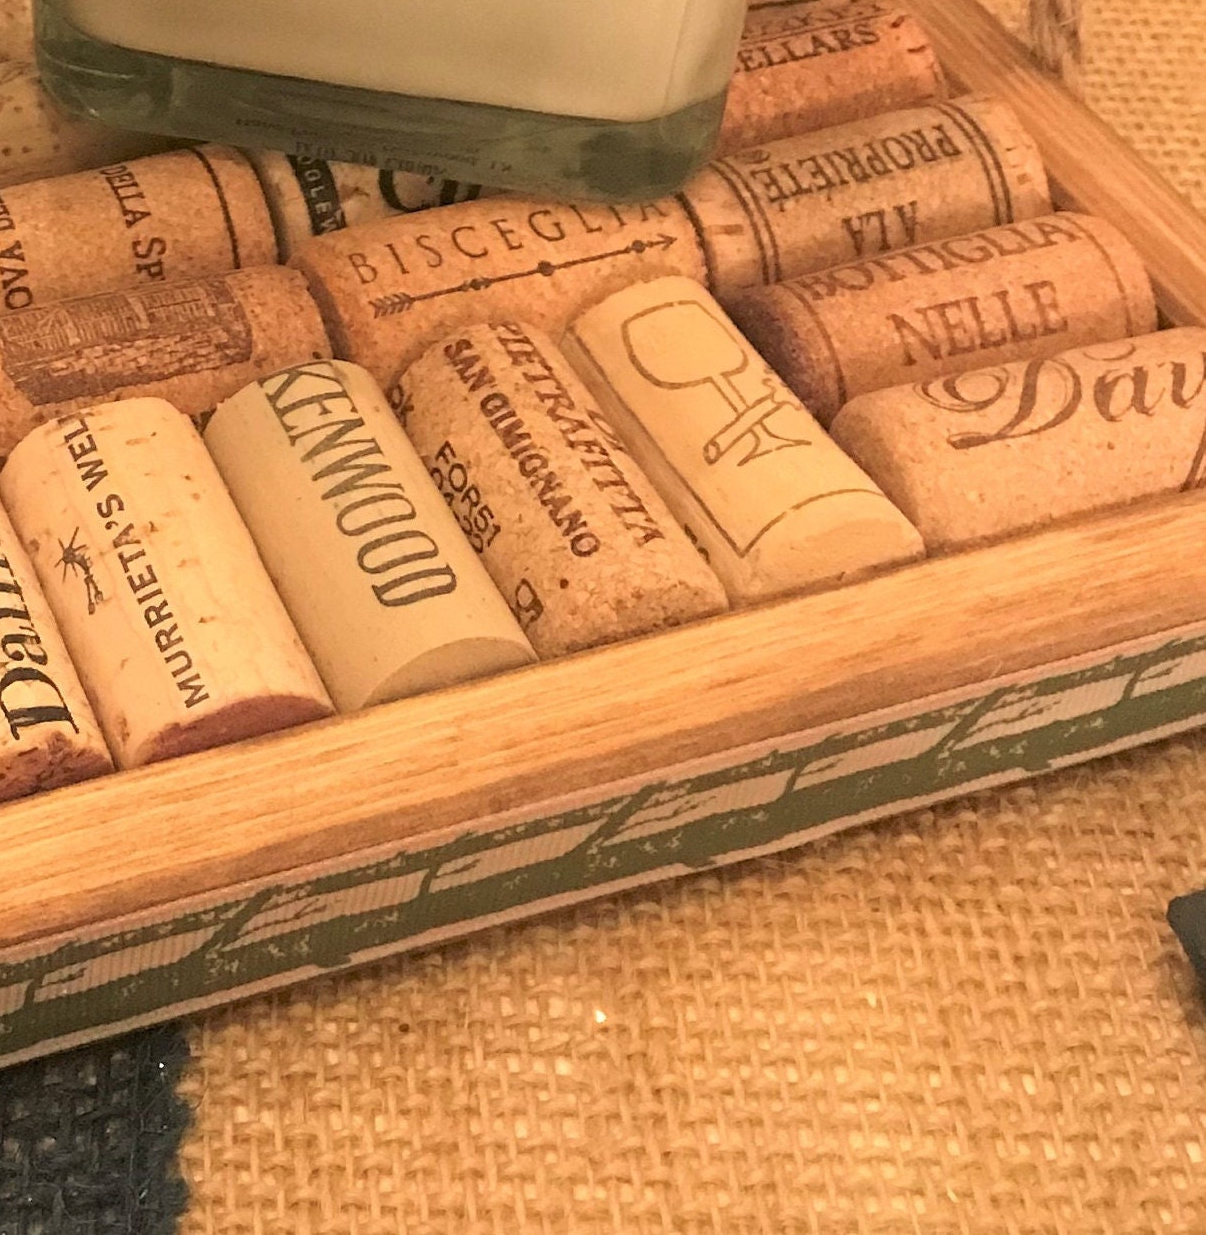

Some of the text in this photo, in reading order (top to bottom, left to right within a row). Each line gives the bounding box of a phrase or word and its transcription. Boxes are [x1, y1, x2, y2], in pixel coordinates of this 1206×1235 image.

[735, 22, 881, 72] ELLARS
[131, 235, 168, 284] SP
[885, 278, 1069, 367] NELLE
[443, 337, 498, 393] SAN
[479, 392, 601, 558] GIMIGNANO
[913, 350, 1206, 451] Dav
[256, 359, 458, 607] KENWOOD
[95, 492, 211, 710] MURRIETA'S
